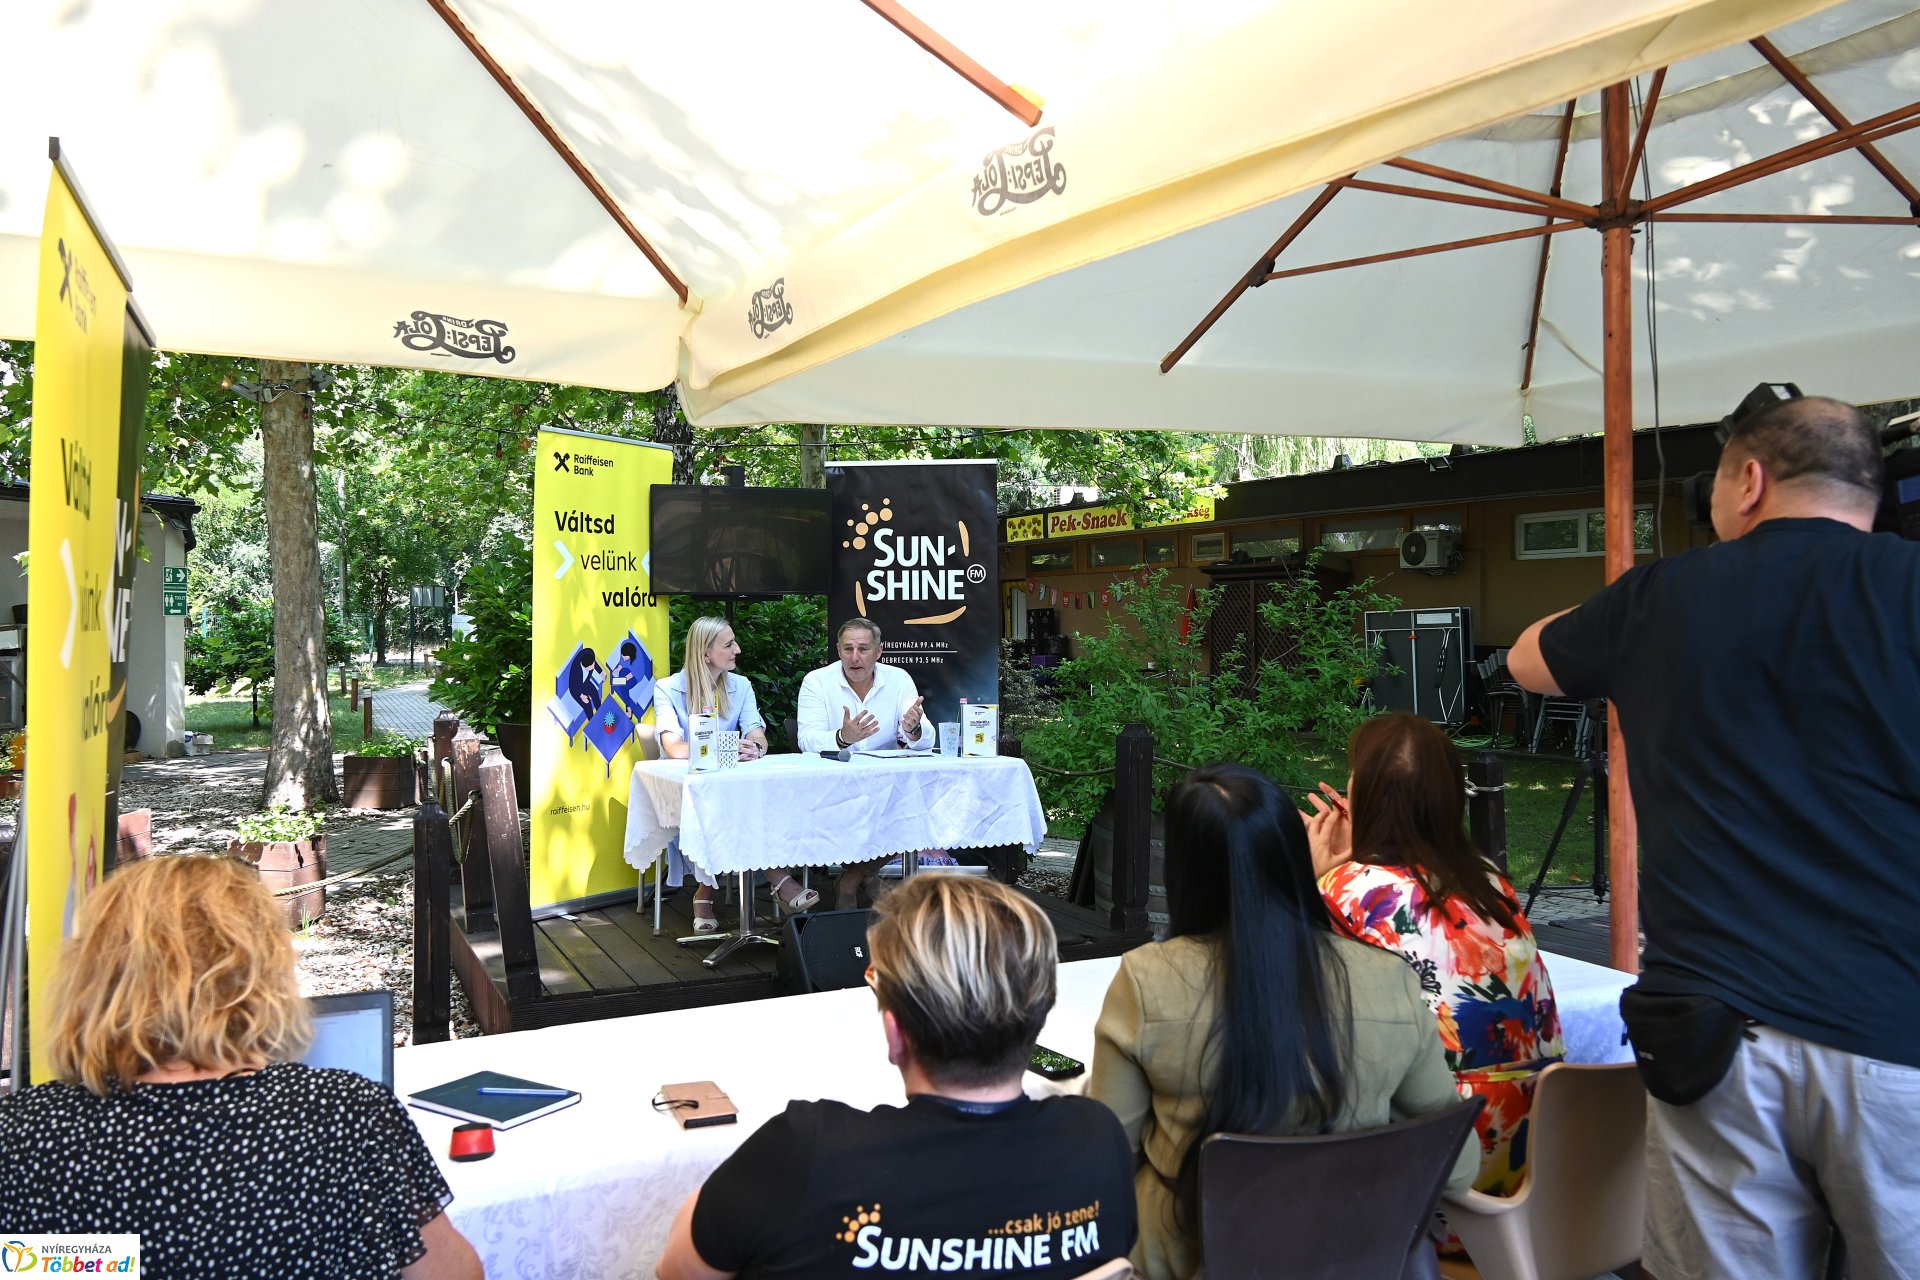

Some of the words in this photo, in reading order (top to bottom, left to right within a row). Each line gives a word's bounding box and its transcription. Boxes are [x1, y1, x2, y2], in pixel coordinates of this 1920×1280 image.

[574, 454, 614, 468] Raiffeisen
[574, 465, 594, 476] Bank
[554, 510, 615, 534] Váltsd
[1050, 508, 1127, 533] Pek-Snack
[873, 527, 956, 567] SUN-
[580, 550, 637, 571] velünk
[866, 569, 965, 602] SHINE
[602, 586, 657, 607] valóra
[880, 640, 919, 649] YÍREGYHÁZA
[920, 641, 934, 649] 99.4
[935, 641, 949, 649] MHz
[881, 656, 913, 664] DEBRECEN
[550, 803, 590, 815] raiffeisen.hu
[1046, 1210, 1061, 1234] jó
[1064, 1200, 1099, 1226] zene!
[852, 1225, 1052, 1272] SUNSHINE
[1061, 1221, 1100, 1261] FM
